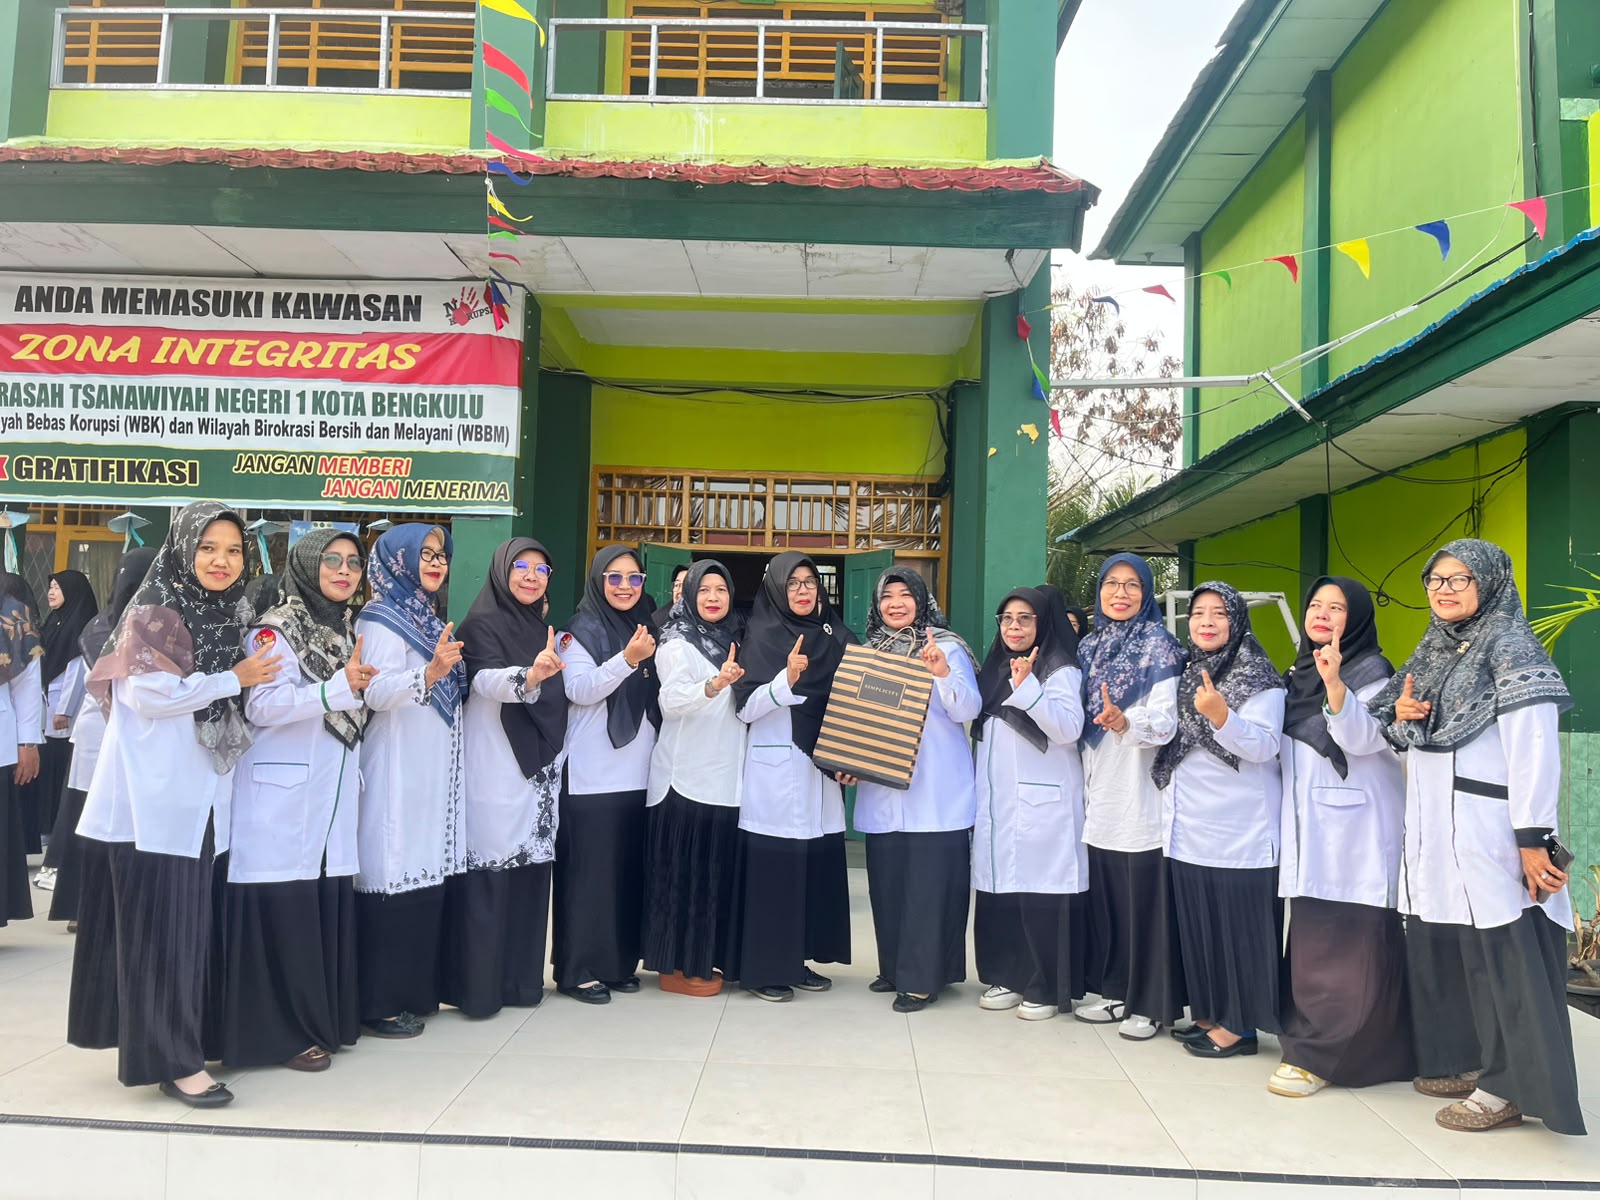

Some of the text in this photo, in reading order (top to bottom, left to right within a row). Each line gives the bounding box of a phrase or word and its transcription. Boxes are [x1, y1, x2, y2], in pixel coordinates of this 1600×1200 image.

[14, 285, 422, 322] ANDA MEMASUKI KAWASAN
[11, 333, 421, 370] ZONA INTEGRITAS
[69, 383, 209, 413] TSANAWIYAH
[214, 387, 291, 415] NEGERI
[295, 389, 306, 415] 1
[311, 390, 367, 417] KOTA
[371, 391, 484, 420] BENGKULU
[26, 412, 66, 431] Bebas
[69, 414, 120, 436] Korupsi
[124, 415, 165, 438] (WBK)
[169, 417, 193, 435] dan
[197, 417, 250, 440] Wilayah
[254, 419, 315, 438] Birokrasi
[319, 420, 362, 440] Bersih
[365, 422, 390, 440] dan
[394, 422, 453, 445] Melayani
[457, 424, 510, 447] (WBBM)
[14, 456, 198, 485] GRATIFIKASI
[234, 454, 412, 476] JANGAN MEMBERI
[322, 478, 510, 501] JANGAN MENERIMA
[864, 684, 899, 697] SIMPLICITY
